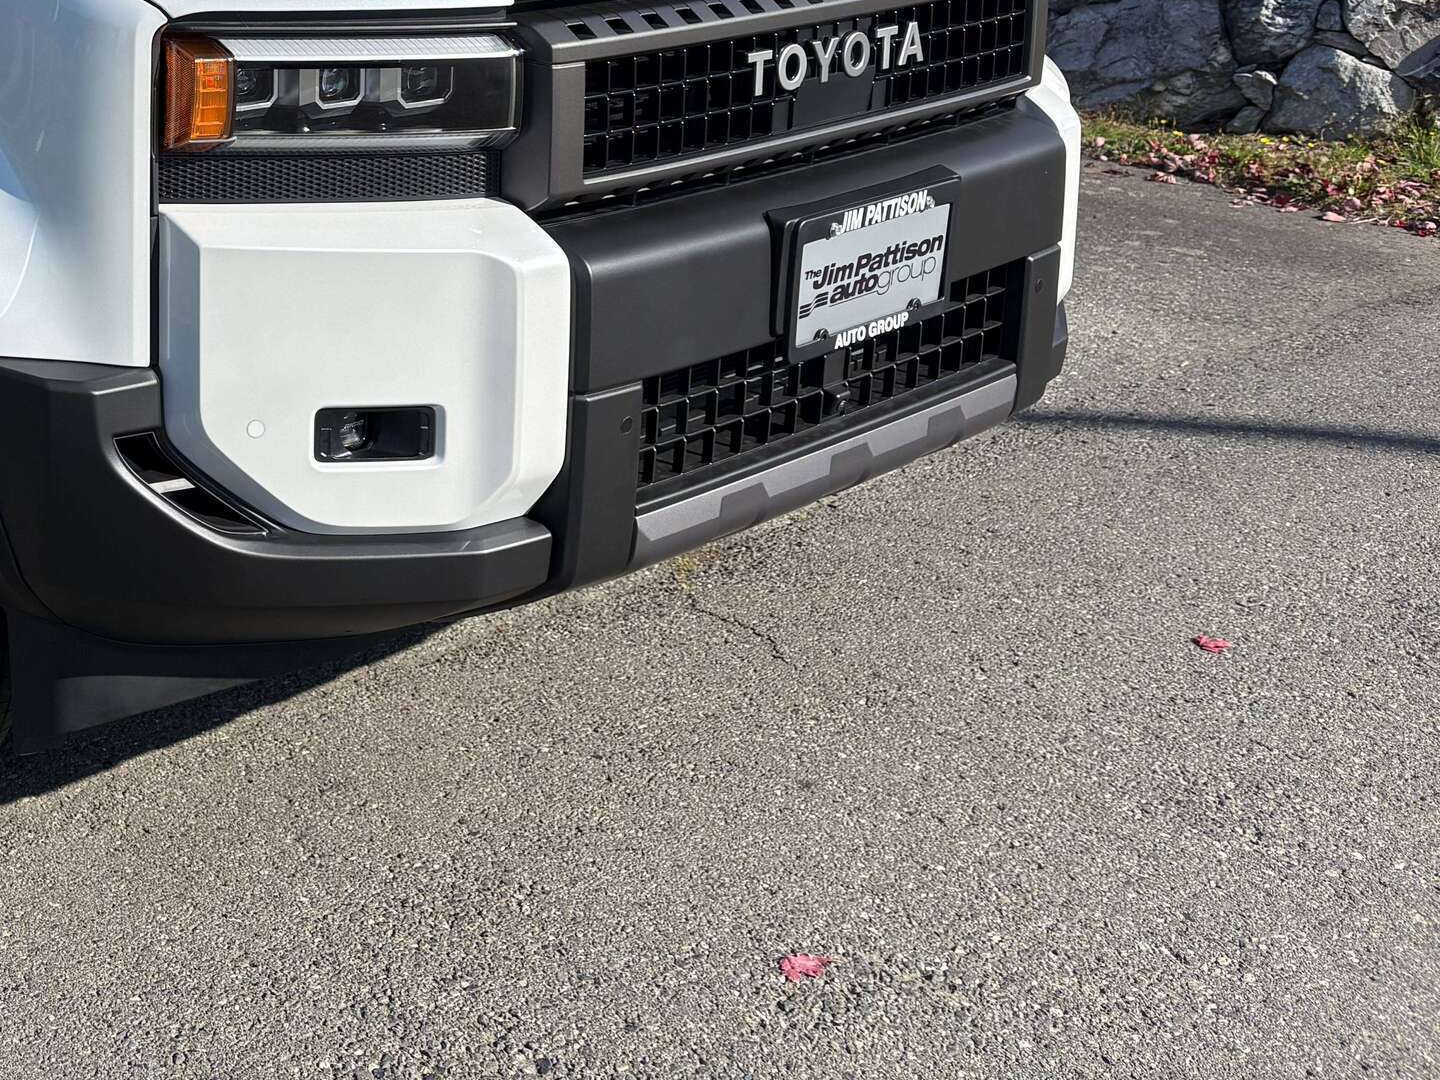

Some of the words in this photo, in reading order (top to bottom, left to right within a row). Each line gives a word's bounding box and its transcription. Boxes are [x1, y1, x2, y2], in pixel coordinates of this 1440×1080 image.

[747, 21, 924, 97] TOYOTA
[836, 207, 864, 236] JIM
[865, 190, 928, 227] PATTISON
[804, 268, 822, 281] The
[834, 328, 866, 350] AUTO
[868, 311, 909, 339] GROUP
